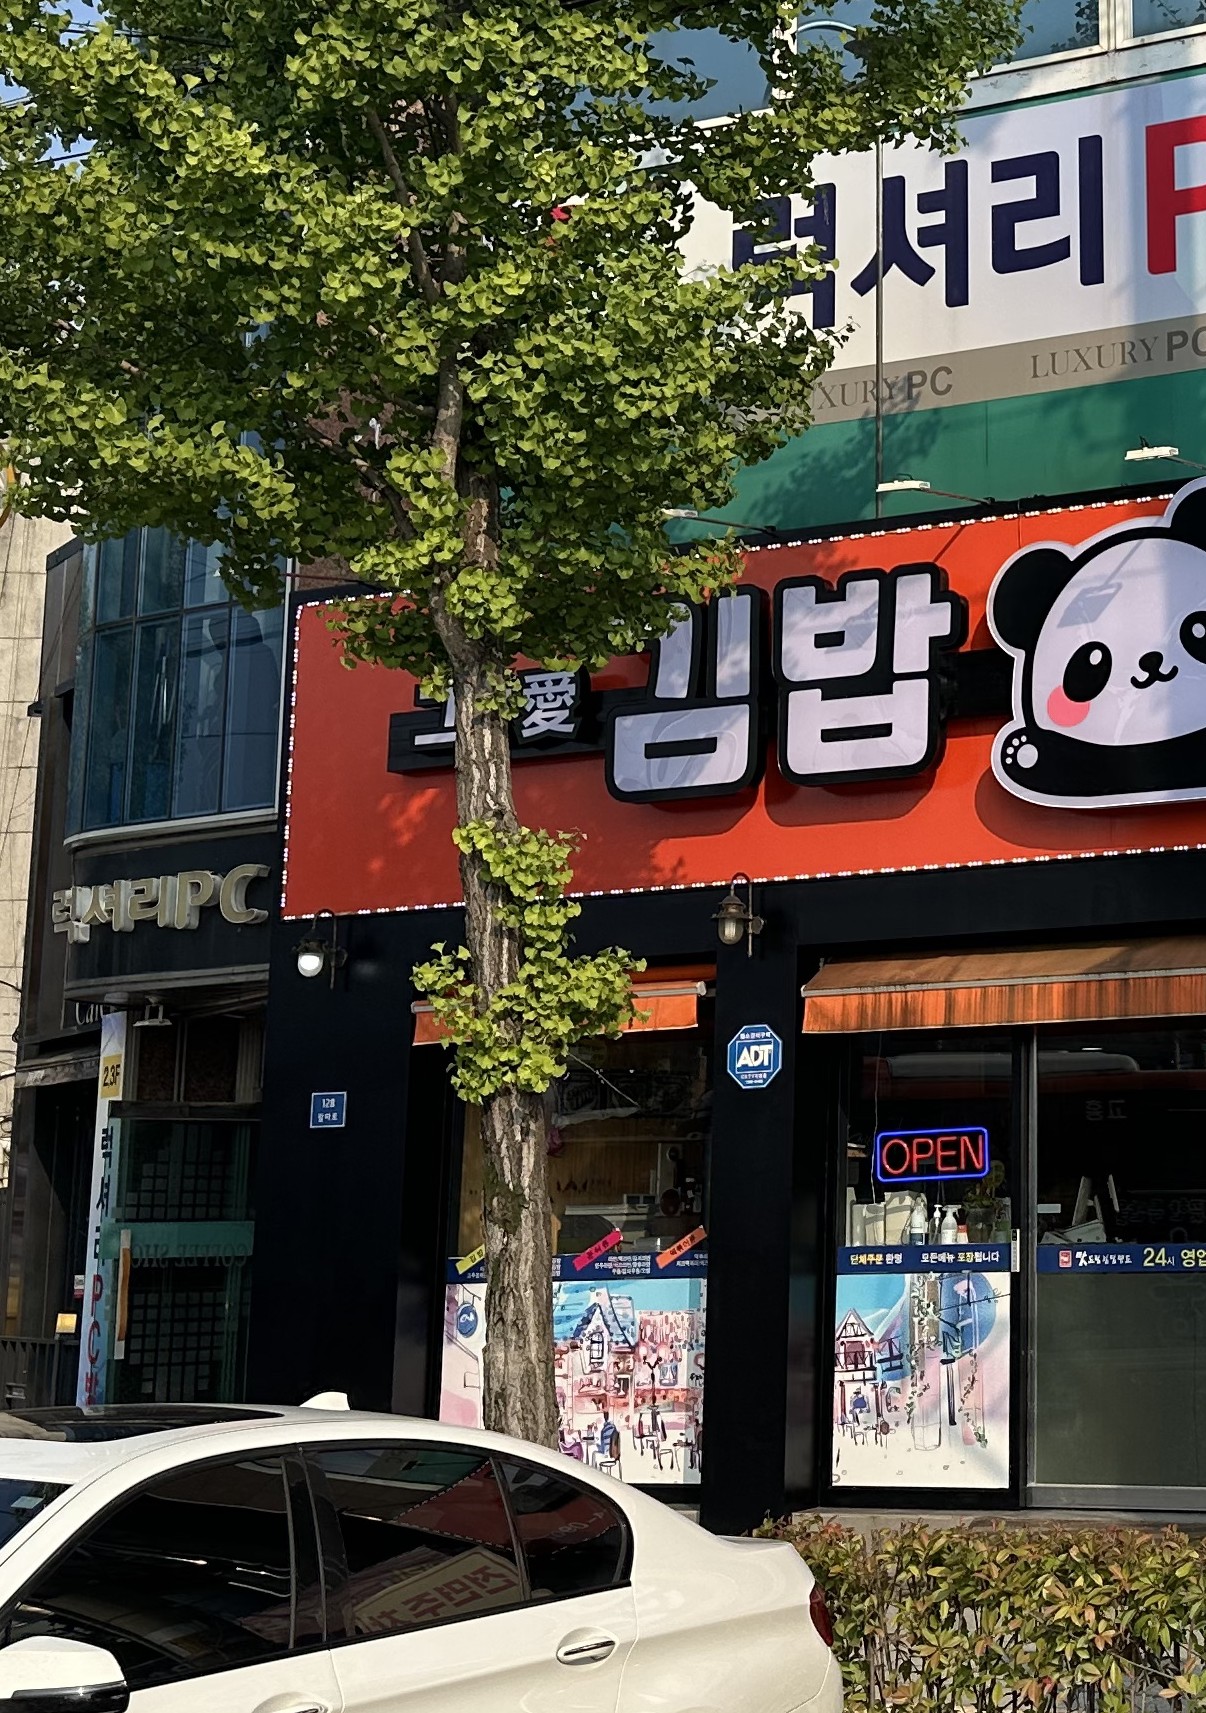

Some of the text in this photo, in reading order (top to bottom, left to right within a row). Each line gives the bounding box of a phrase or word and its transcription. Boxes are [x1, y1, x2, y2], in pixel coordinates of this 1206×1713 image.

[1030, 334, 1159, 380] LUXURY
[811, 365, 953, 411] XURY PC
[52, 863, 271, 944] 럭셔리PC
[737, 1044, 773, 1068] ADT
[881, 1134, 984, 1175] OPEN
